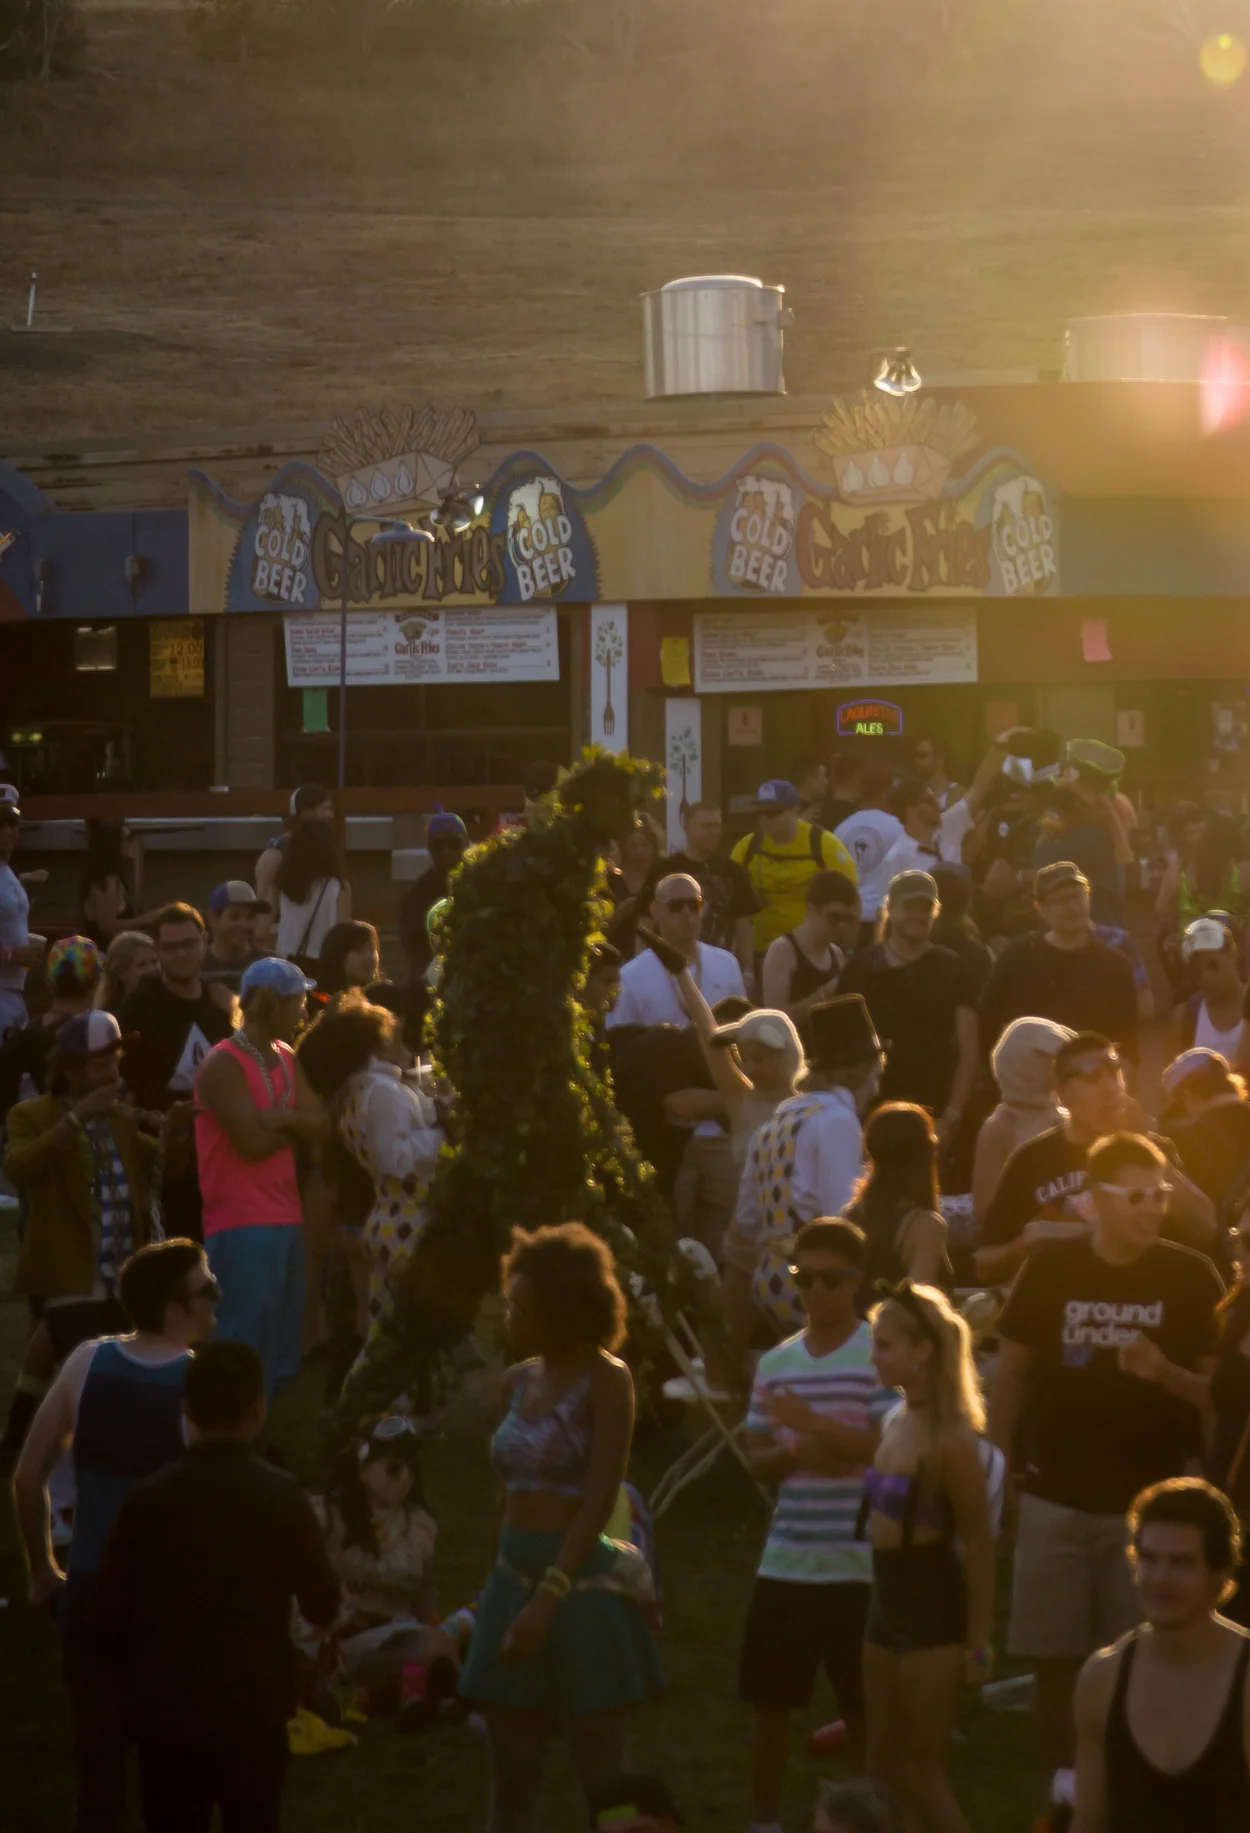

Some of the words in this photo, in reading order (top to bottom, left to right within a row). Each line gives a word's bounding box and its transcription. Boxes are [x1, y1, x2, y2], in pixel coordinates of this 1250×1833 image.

[255, 525, 306, 571] COLD
[518, 515, 573, 561] COLD
[731, 506, 791, 559] COLD
[796, 503, 911, 590] Garlic
[908, 503, 991, 590] Fries
[1001, 513, 1053, 556] COLD
[313, 513, 423, 601] Garlic
[421, 517, 507, 601] Fries
[517, 547, 577, 602] BEER
[730, 545, 789, 593] BEER
[999, 545, 1058, 596] BEER
[255, 559, 308, 605] BEER
[856, 722, 884, 735] ALES
[1065, 1299, 1164, 1328] ground
